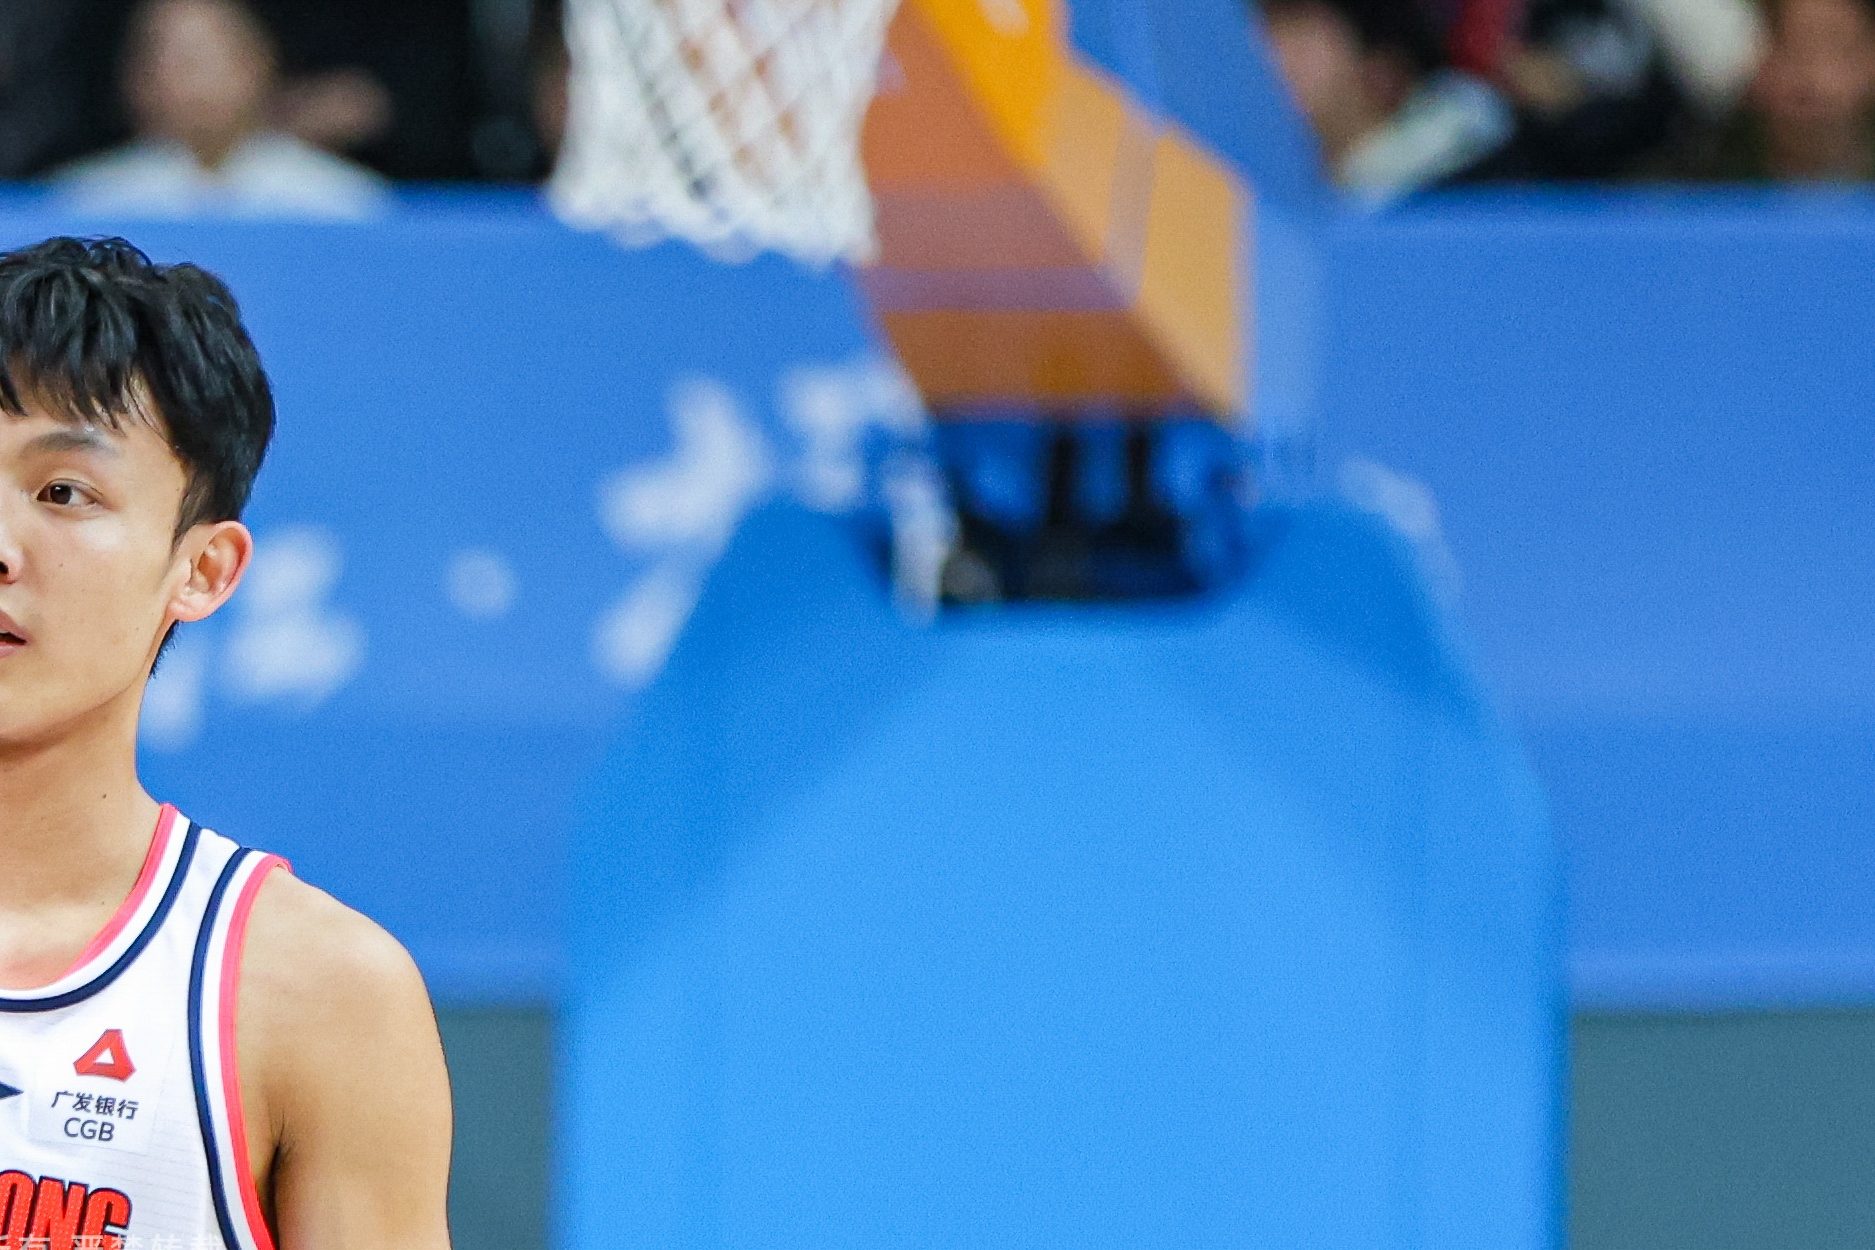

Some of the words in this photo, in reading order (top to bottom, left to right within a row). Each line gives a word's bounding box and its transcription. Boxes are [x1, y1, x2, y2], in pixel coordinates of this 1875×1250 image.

[51, 1090, 139, 1120] 广发银行
[63, 1117, 115, 1142] CGB
